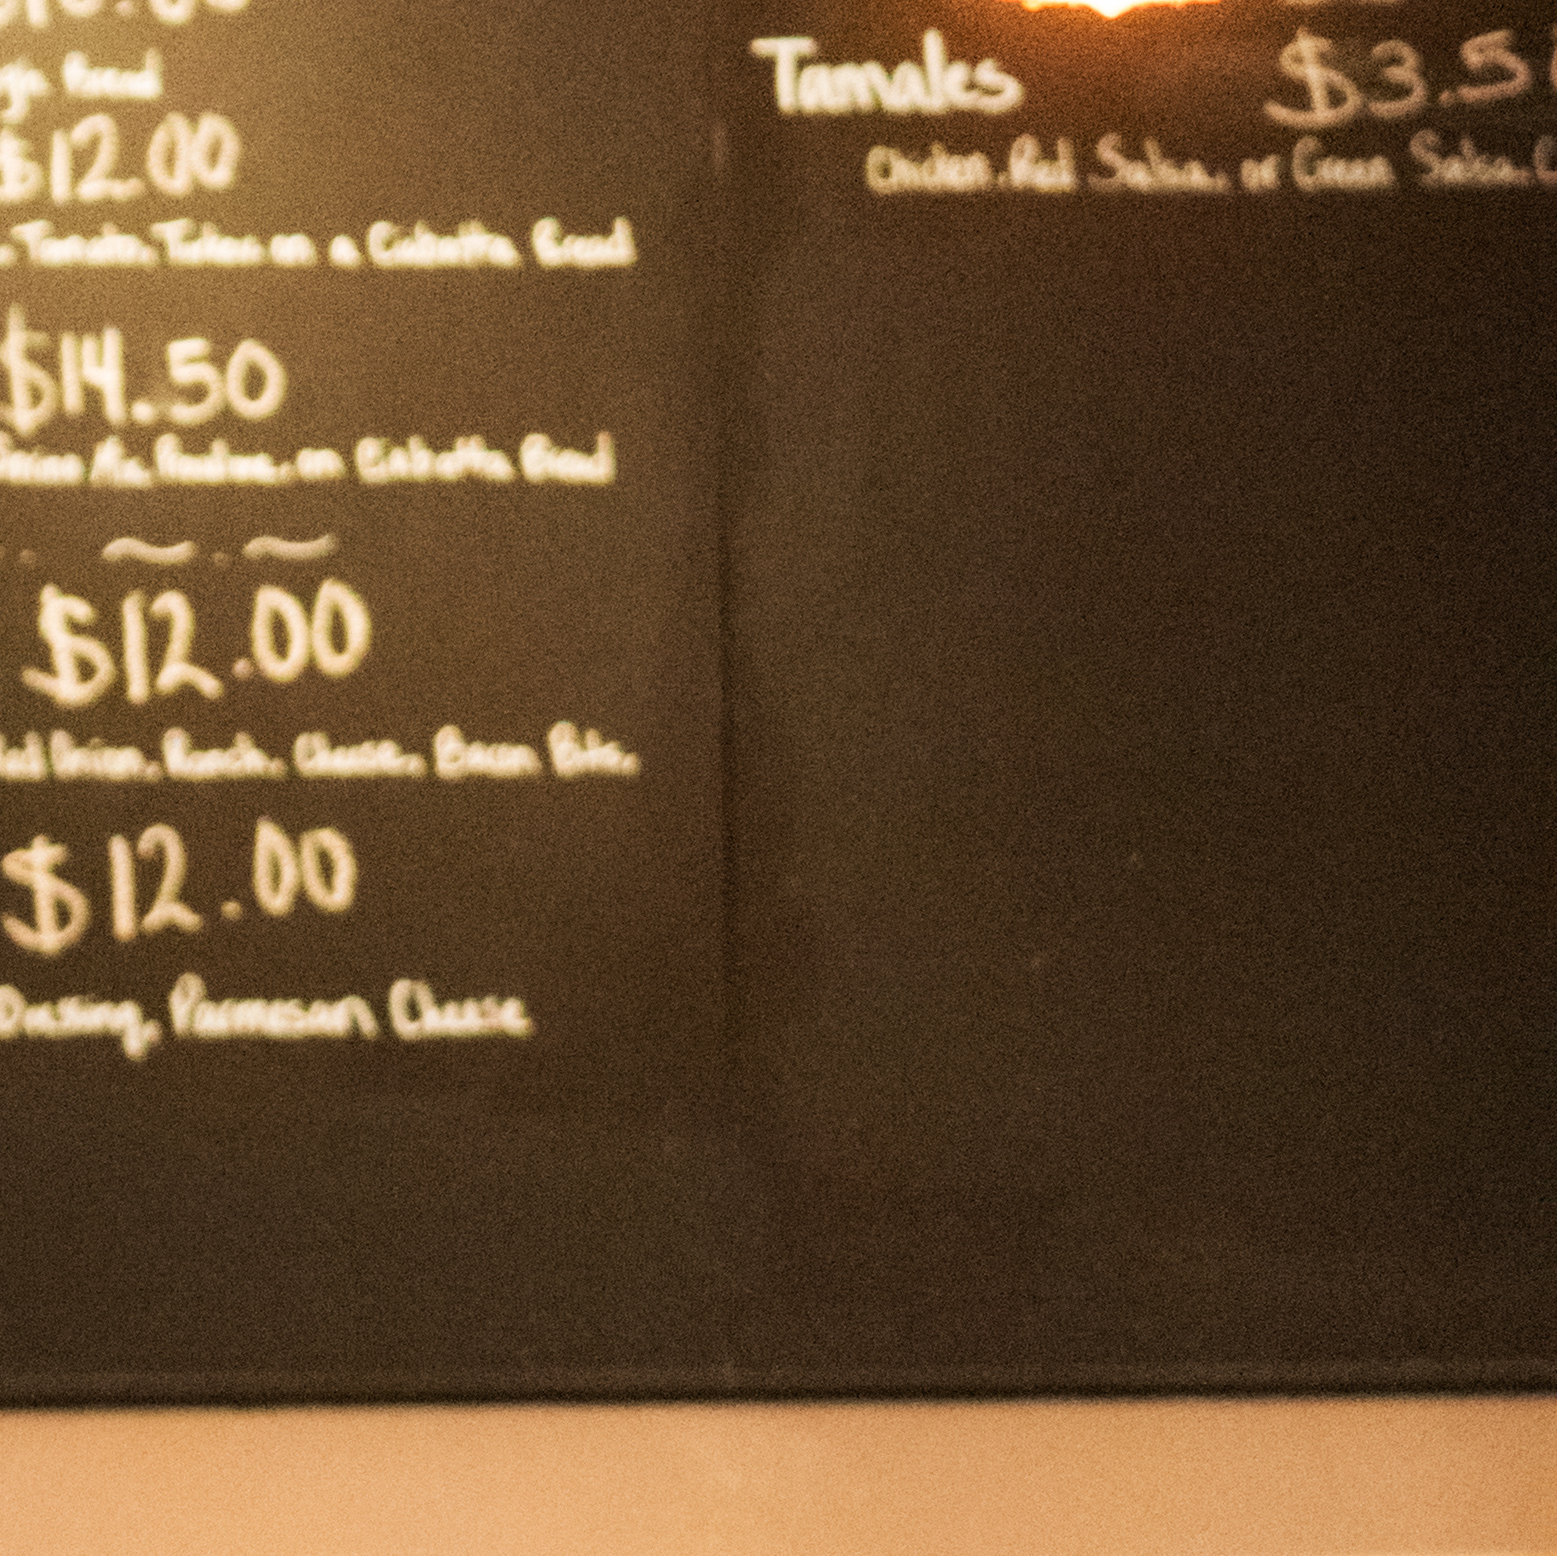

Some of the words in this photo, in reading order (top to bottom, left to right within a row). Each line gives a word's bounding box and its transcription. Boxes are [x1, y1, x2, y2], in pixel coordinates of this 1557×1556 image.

[750, 28, 1025, 116] Tamales
[1263, 25, 1557, 130] $3.5
[21, 577, 373, 708] $12.00
[1, 814, 358, 958] $12.00
[168, 971, 380, 1041] Parmesan
[390, 976, 536, 1042] Cheese
